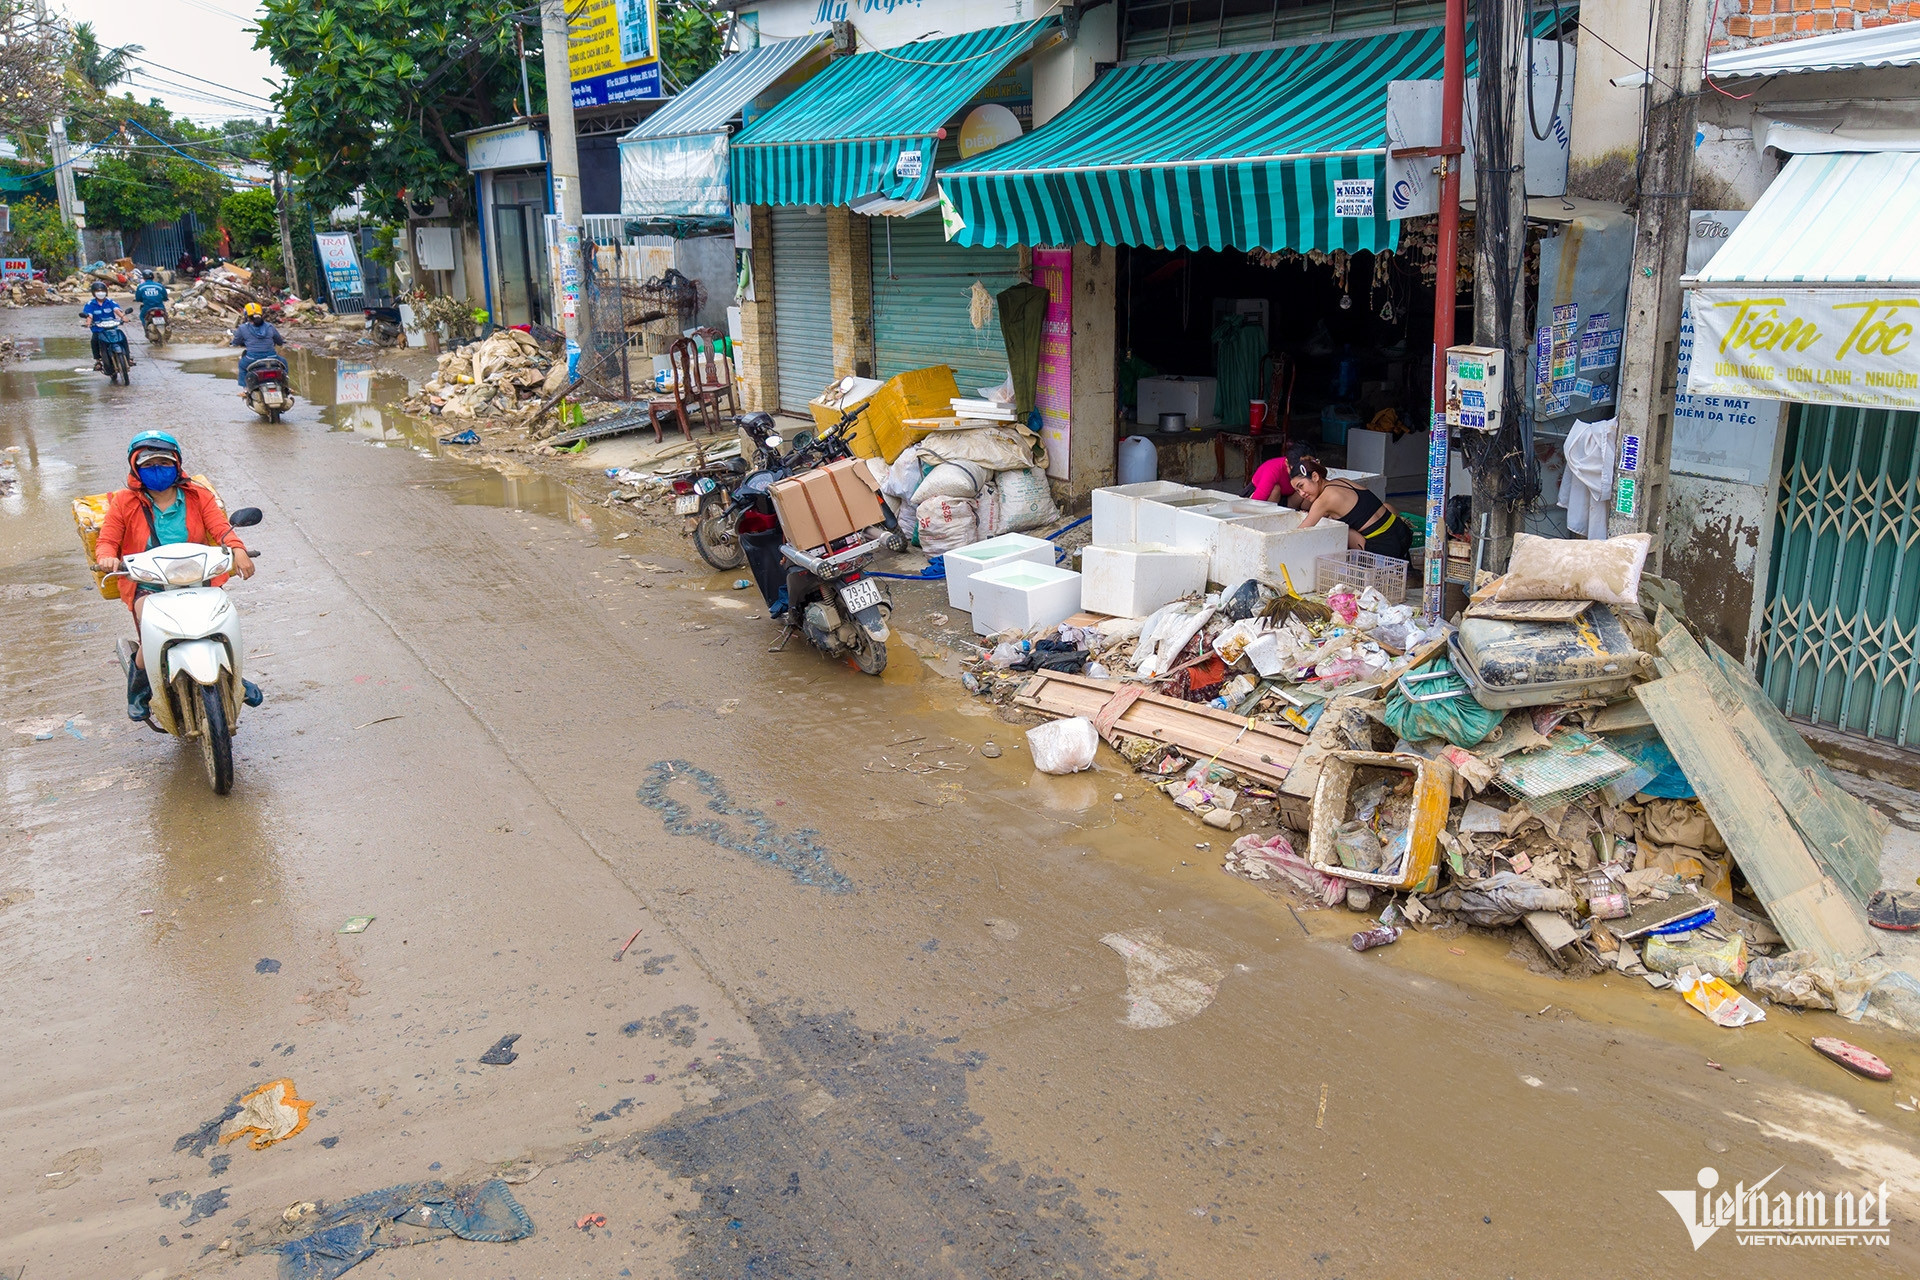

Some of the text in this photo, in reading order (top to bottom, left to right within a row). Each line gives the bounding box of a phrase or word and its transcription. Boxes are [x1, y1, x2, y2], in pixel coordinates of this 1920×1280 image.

[1344, 186, 1366, 195] NASA
[1695, 220, 1729, 239] Tóc
[5, 261, 27, 270] BIN
[1712, 297, 1920, 361] Tiệm Tóc
[1741, 362, 1775, 381] NÓNG
[1787, 362, 1812, 383] UỐN
[1817, 369, 1852, 388] LẠNH
[1865, 368, 1918, 393] NHUỘM
[1705, 397, 1720, 407] SE
[1729, 413, 1756, 425] TIỆC
